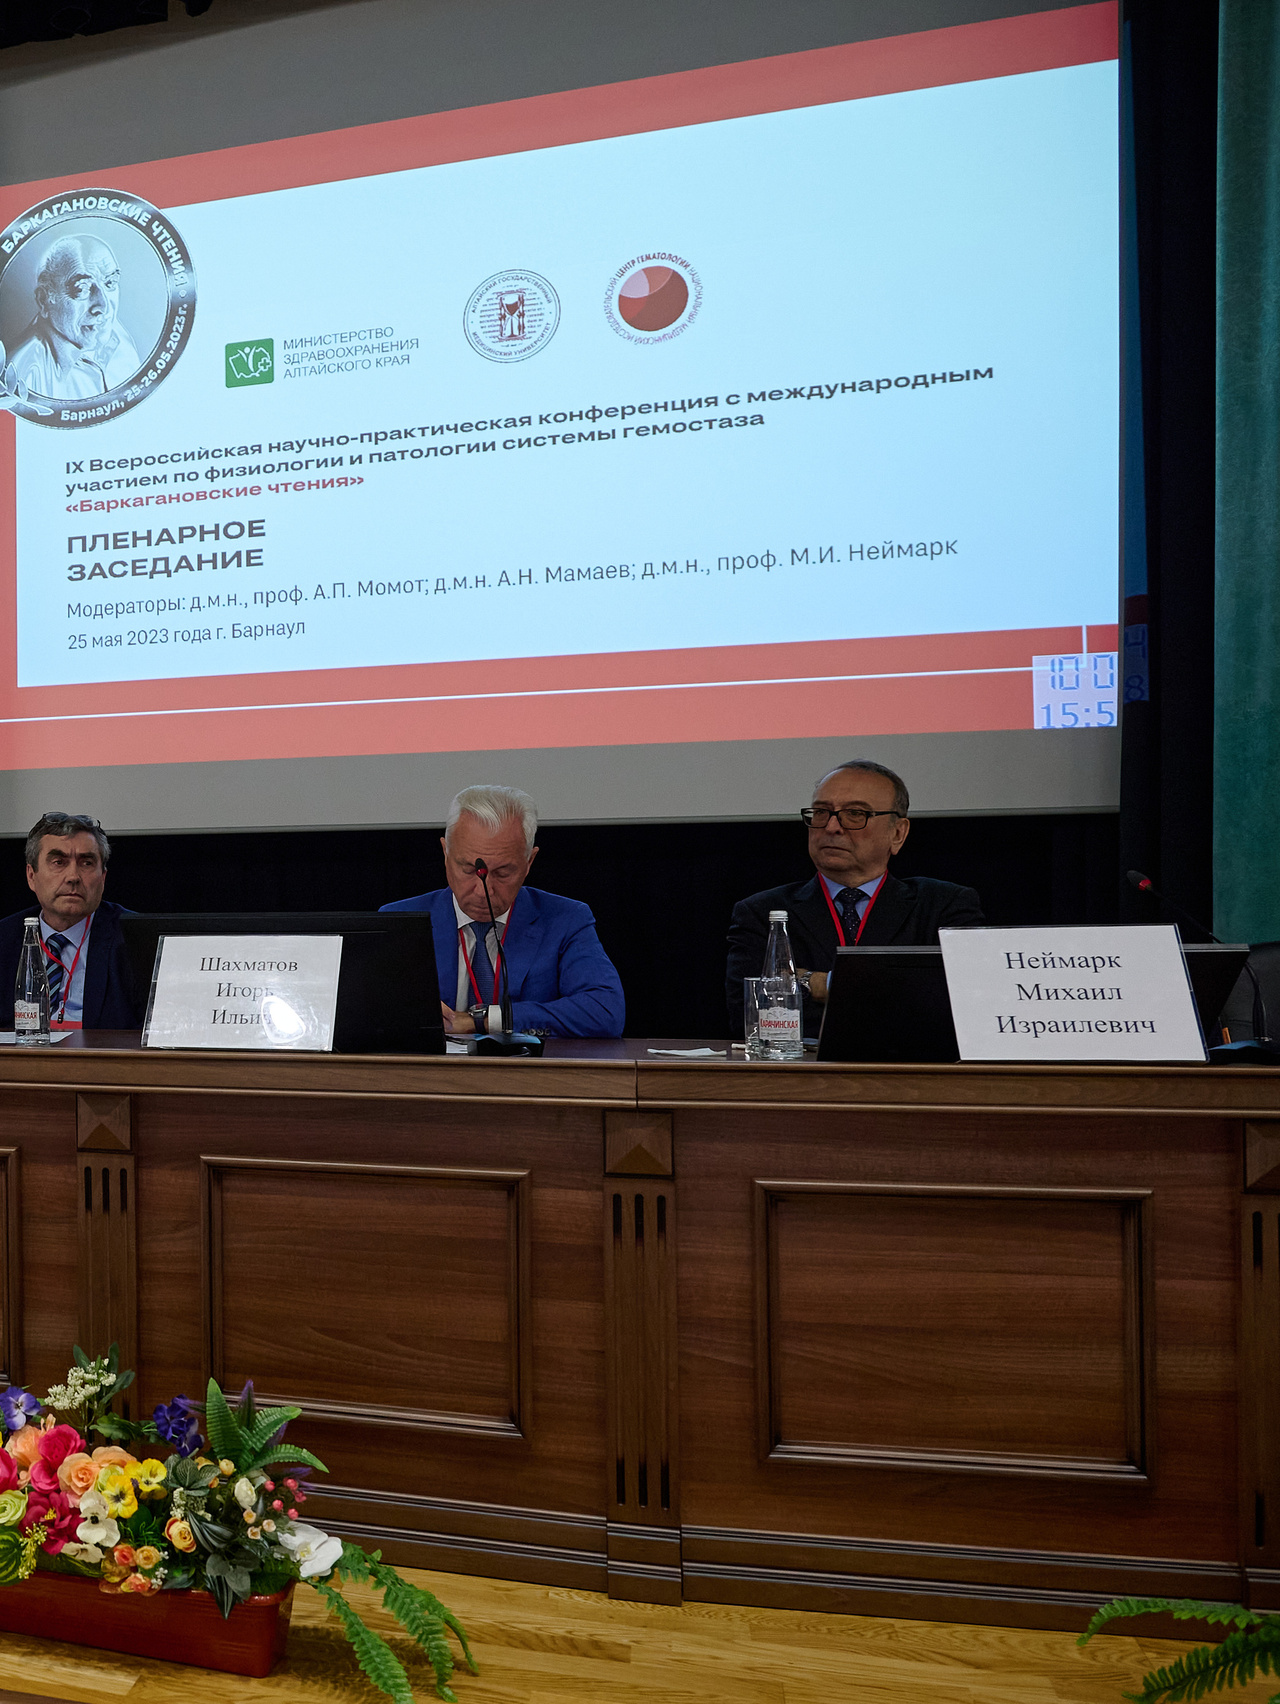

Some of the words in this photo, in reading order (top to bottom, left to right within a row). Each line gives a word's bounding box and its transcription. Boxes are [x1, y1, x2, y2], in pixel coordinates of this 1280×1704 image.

[1, 197, 151, 253] БАРКАГАНОВСКИЕ
[151, 220, 190, 286] ЧТЕНИЯ
[615, 259, 636, 278] ЦЕНТР
[636, 252, 691, 269] ГЕМАТОЛОГИИ
[284, 326, 394, 350] МИНИСТЕРСТВО
[283, 338, 419, 365] ЗДРАВООХРАНЕНИЯ
[284, 359, 372, 379] АЛТАЙСКОГО
[375, 354, 410, 369] КРАЯ
[61, 399, 124, 422] Барнаул,
[66, 460, 84, 474] IX
[90, 444, 263, 473] Всероссийская
[268, 414, 532, 454] научно-практическая
[539, 396, 719, 425] конференция
[725, 394, 741, 406] с
[747, 367, 993, 403] международным
[65, 474, 168, 497] участием
[174, 471, 199, 483] по
[205, 456, 343, 483] физиологии
[350, 454, 362, 465] и
[369, 441, 496, 463] патологии
[502, 429, 617, 450] системы
[623, 413, 765, 438] гемостаза
[66, 485, 262, 513] «Баркагановские
[268, 476, 364, 494] чтения»
[67, 518, 266, 553] ПЛЕНАРНОЕ
[66, 548, 264, 581] ЗАСЕДАНИЕ
[67, 597, 185, 620] Модераторы:
[190, 593, 248, 613] д.м.н.,
[254, 585, 308, 608] проф.
[313, 582, 351, 601] А.П.
[358, 578, 429, 598] Момот;
[434, 575, 491, 595] д.м.н.
[497, 568, 539, 587] А.Н.
[545, 563, 636, 584] Мамаев;
[641, 559, 710, 580] д.м.н.,
[718, 549, 782, 574] проф.
[791, 546, 841, 566] М.И.
[849, 540, 958, 562] Неймарк
[68, 634, 87, 650] 25
[92, 635, 122, 649] мая
[127, 628, 169, 646] 2023
[174, 628, 211, 645] года
[216, 628, 227, 641] г.
[232, 621, 305, 643] Барнаул
[199, 957, 298, 972] Шахматов
[1003, 951, 1123, 974] Неймарк
[216, 982, 274, 1001] Игорь
[1015, 983, 1123, 1001] Михаил
[995, 1015, 1157, 1039] Израилевич
